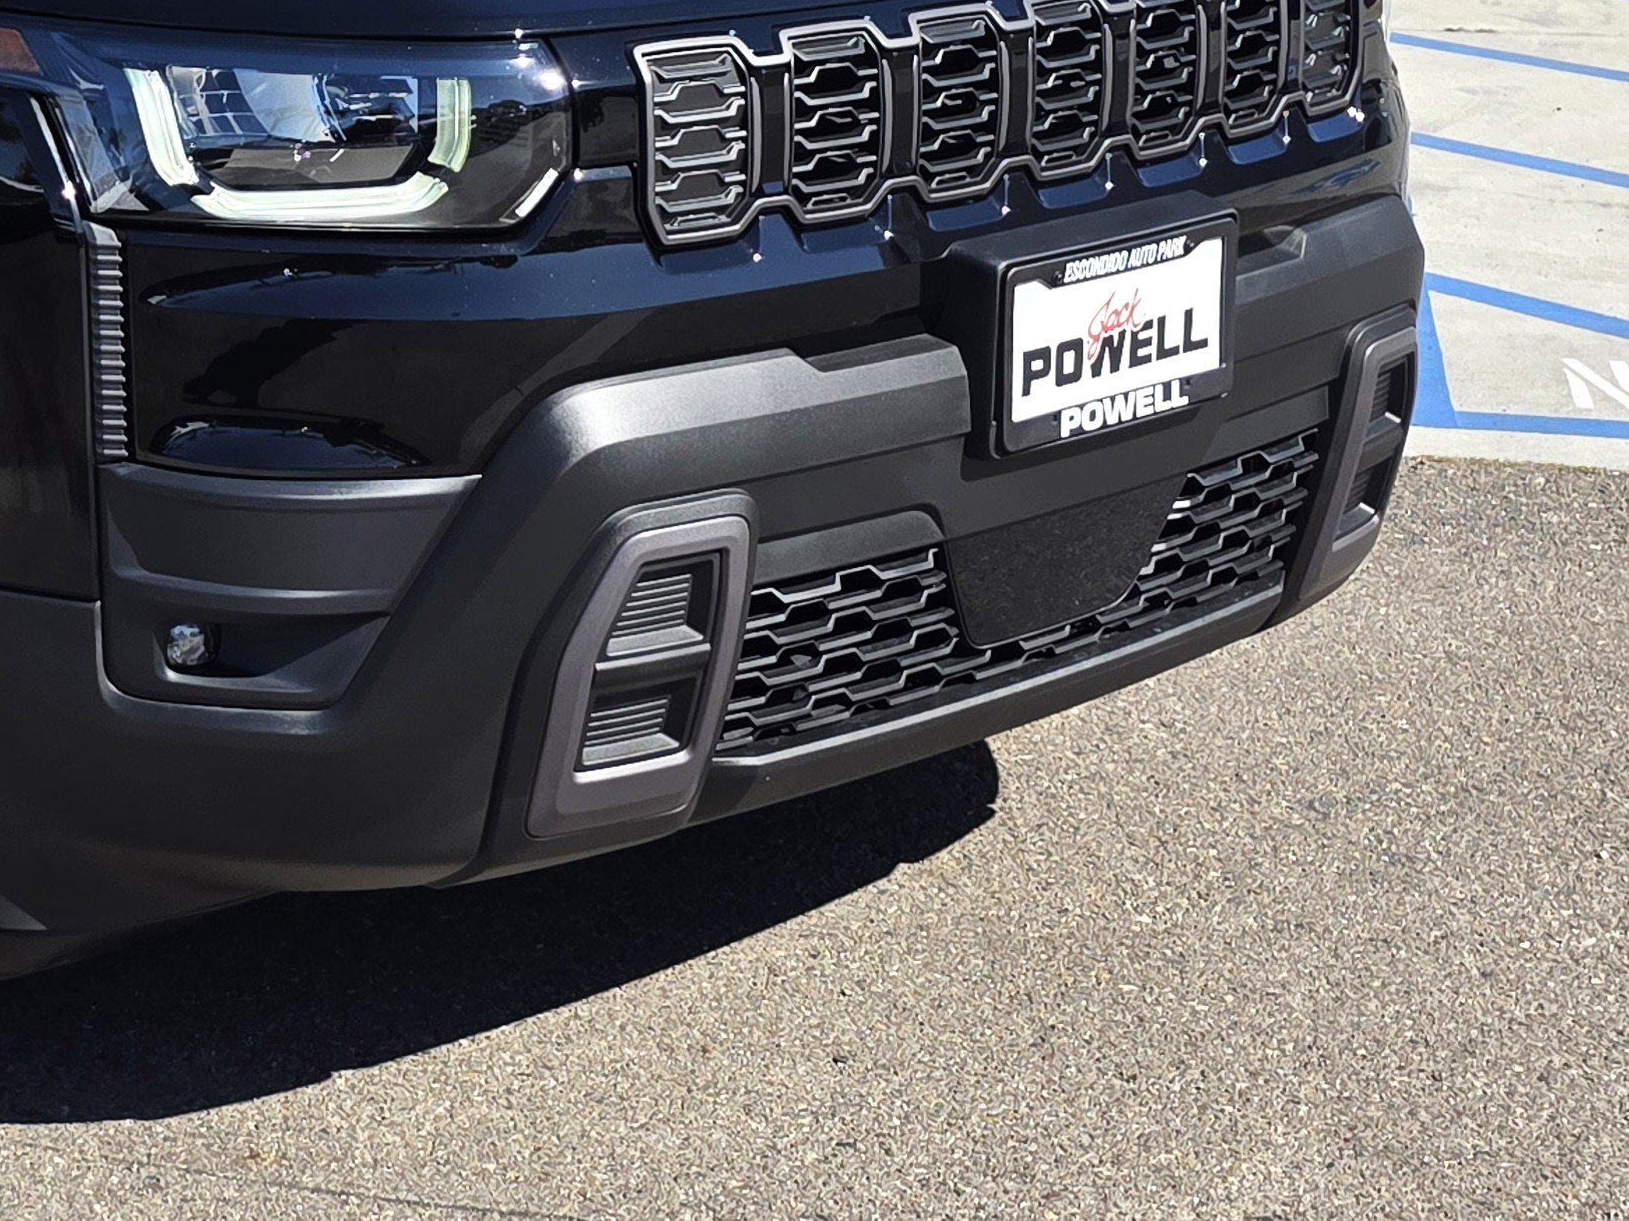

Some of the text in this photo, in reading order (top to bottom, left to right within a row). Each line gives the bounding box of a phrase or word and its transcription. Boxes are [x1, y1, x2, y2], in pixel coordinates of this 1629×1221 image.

[1064, 235, 1187, 283] ESCONDIDO AUTO PARK
[1022, 307, 1208, 397] POWELL
[1060, 379, 1189, 438] POWELL
